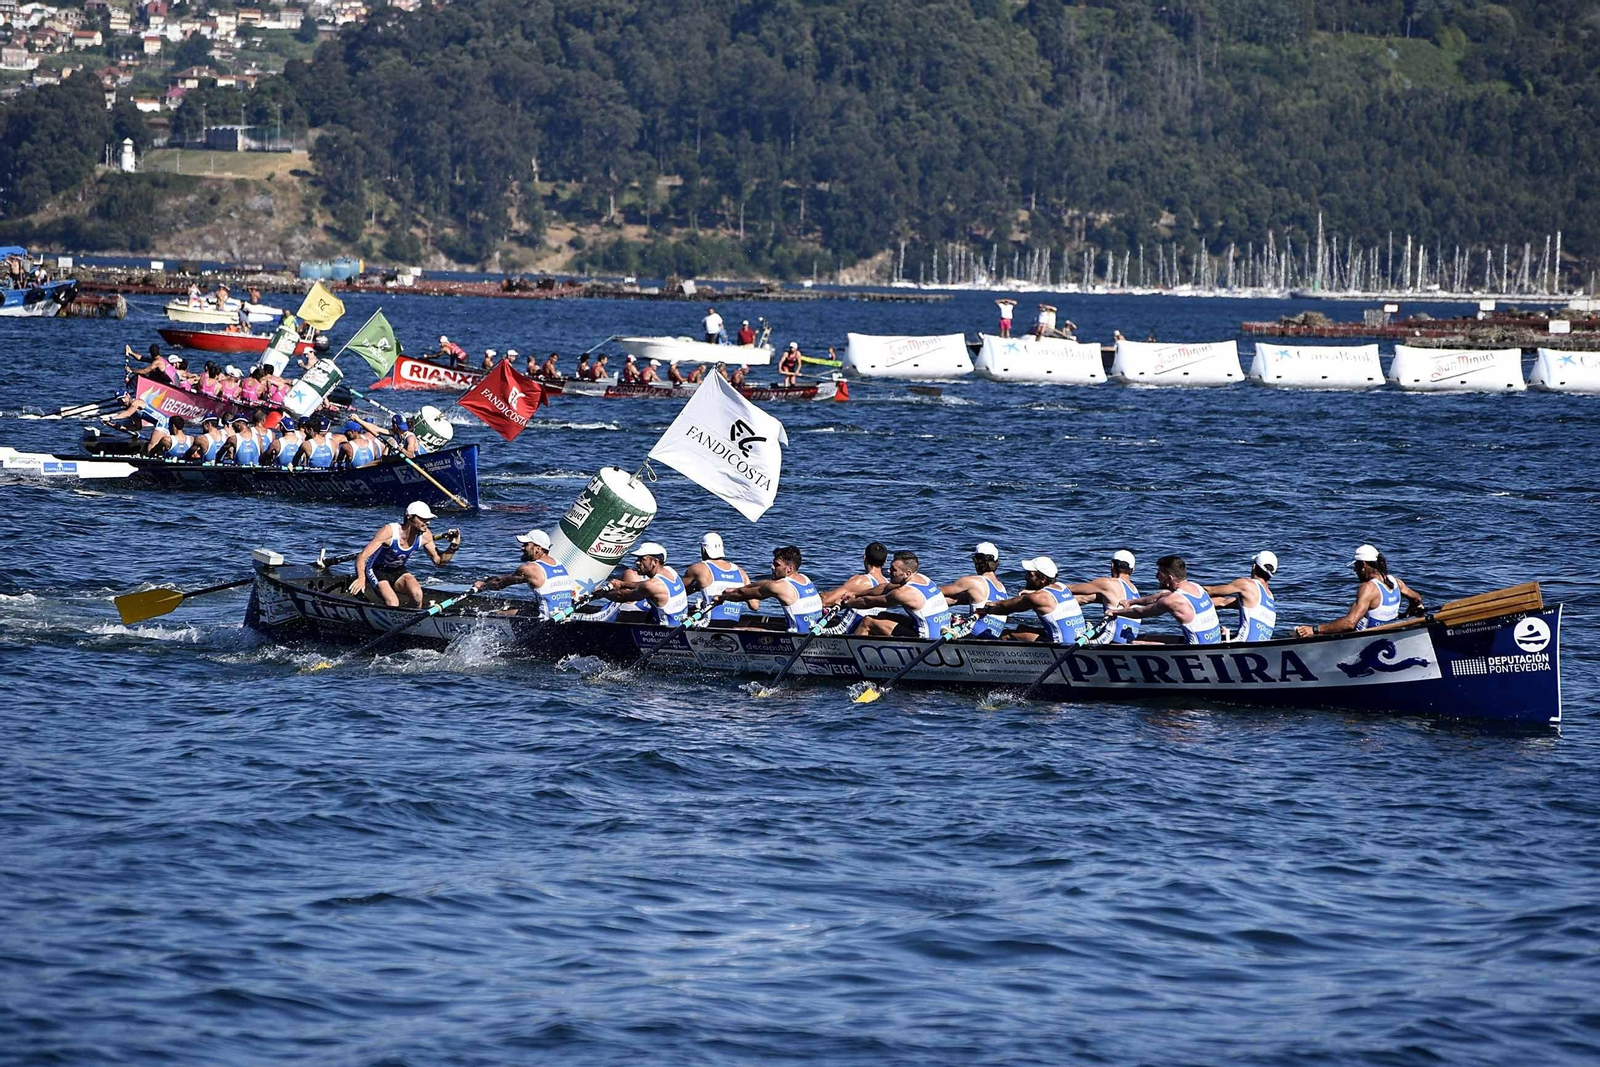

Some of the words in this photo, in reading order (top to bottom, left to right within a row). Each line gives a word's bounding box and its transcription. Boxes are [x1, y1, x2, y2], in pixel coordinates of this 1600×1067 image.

[481, 388, 527, 427] FANDICOSTA
[685, 425, 772, 491] FANDICOSTA
[967, 650, 1006, 658] SERVICIOS
[1488, 652, 1550, 666] DEPUTACIÓN
[824, 663, 861, 675] VEIGA
[1065, 650, 1320, 685] PEREIRA
[1489, 662, 1551, 674] PONTEVEDRA
